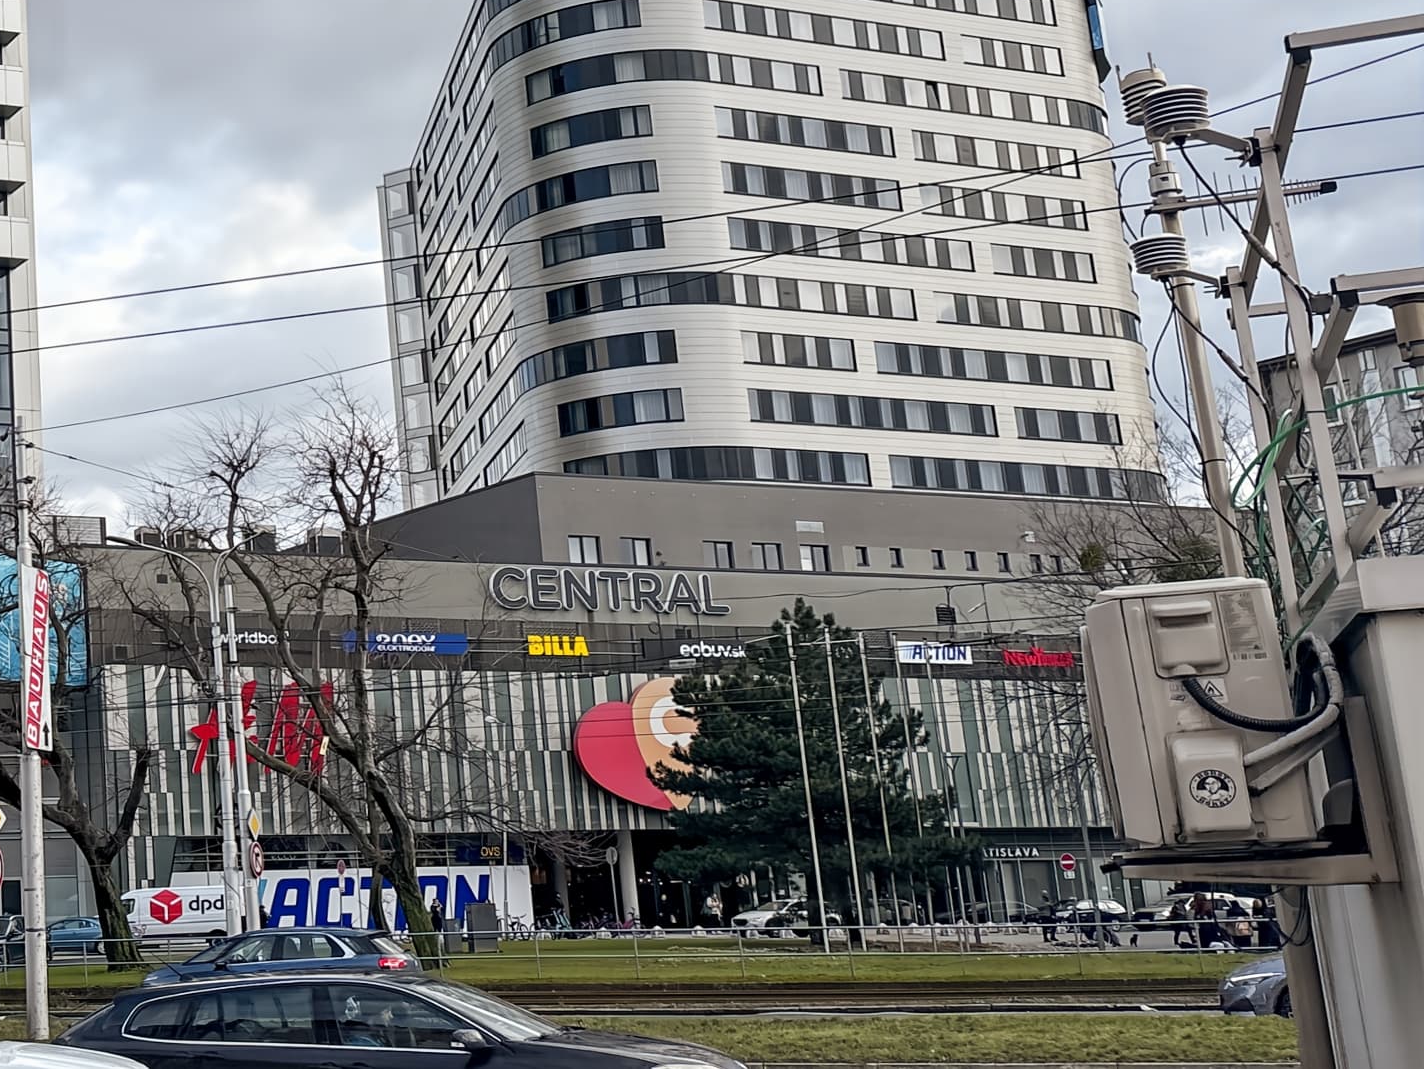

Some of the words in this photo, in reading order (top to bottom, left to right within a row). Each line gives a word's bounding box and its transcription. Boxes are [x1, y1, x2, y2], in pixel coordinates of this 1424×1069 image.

[489, 566, 731, 616] CENTRAL
[527, 634, 590, 657] BILLA
[679, 640, 747, 658] eobuv.sk
[912, 644, 967, 661] ACTION
[26, 572, 48, 749] BAUHAUS
[480, 846, 501, 857] OVS
[188, 894, 225, 915] dpd
